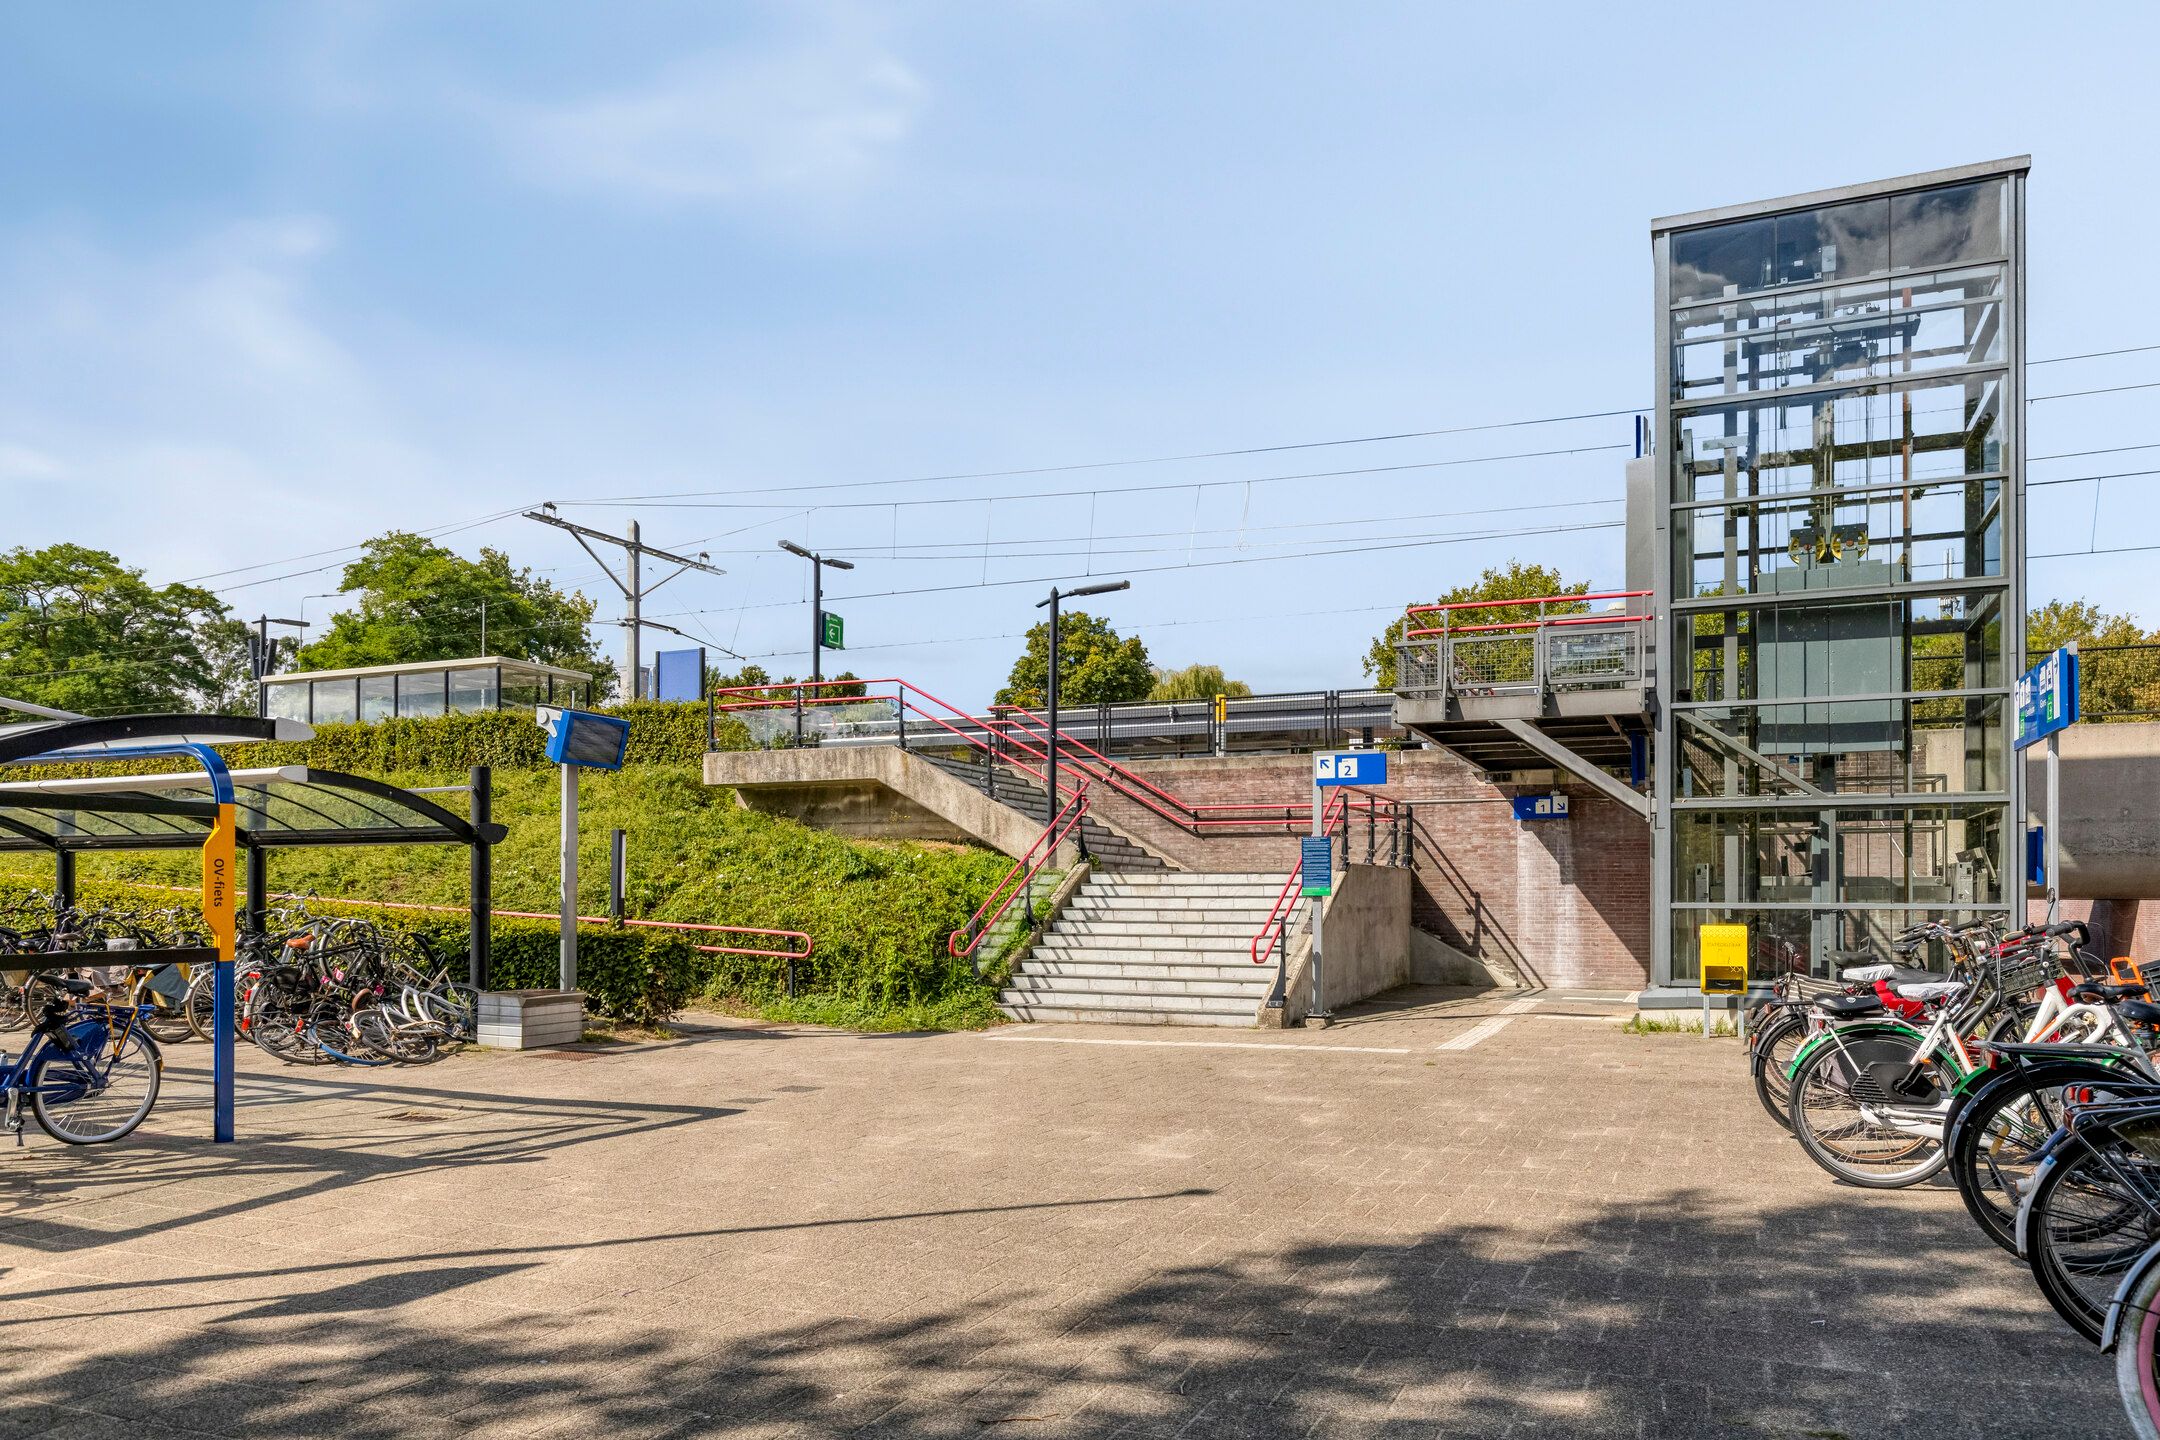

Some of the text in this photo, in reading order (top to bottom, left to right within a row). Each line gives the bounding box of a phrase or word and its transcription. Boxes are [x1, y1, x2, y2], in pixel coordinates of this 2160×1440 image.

[1344, 765, 1352, 776] 2
[1540, 804, 1545, 812] 1
[213, 858, 225, 907] OV-fiets
